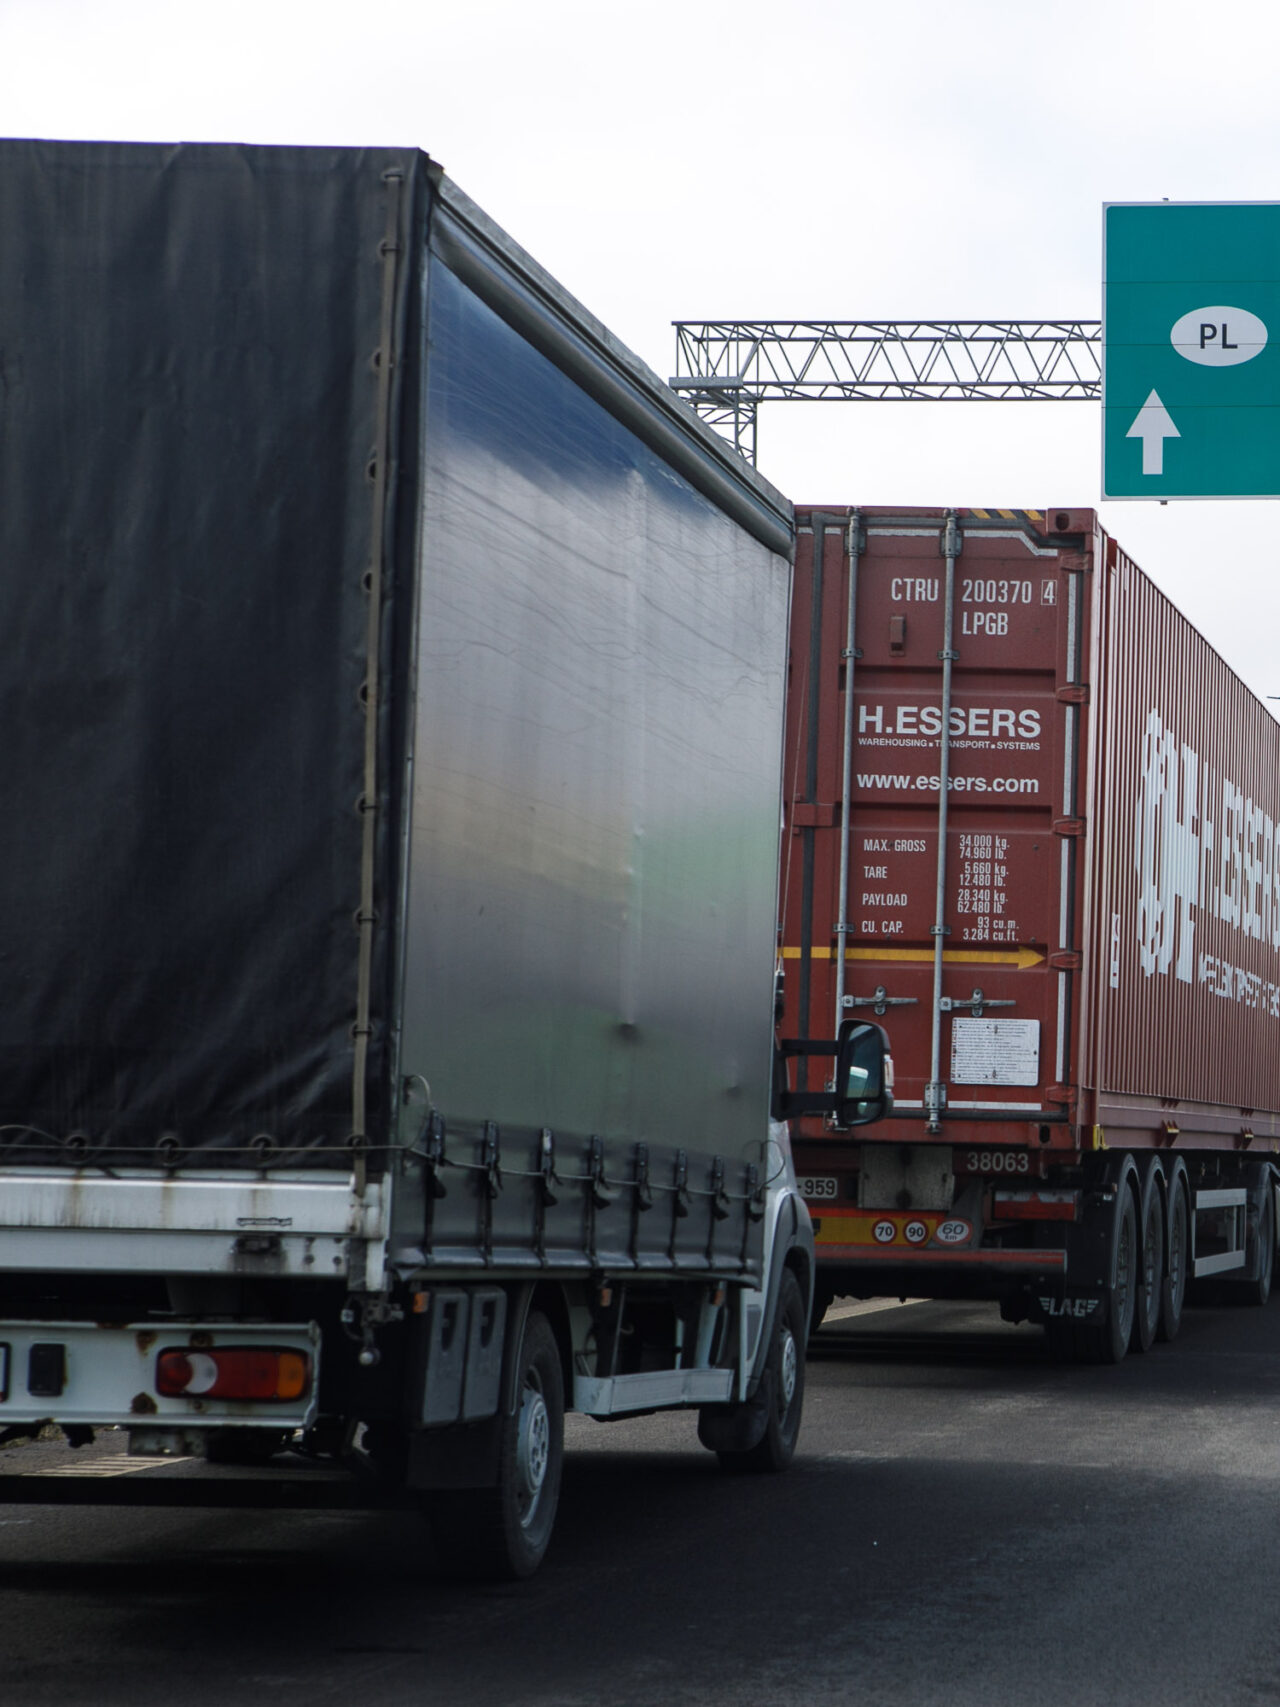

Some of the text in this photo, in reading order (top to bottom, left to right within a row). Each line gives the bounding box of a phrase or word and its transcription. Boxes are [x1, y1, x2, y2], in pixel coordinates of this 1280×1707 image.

[1199, 323, 1238, 350] PL
[891, 578, 1055, 604] CTRU 200370 4
[962, 612, 1009, 635] LPGB
[859, 705, 1041, 738] H.ESSERS
[858, 738, 1041, 750] WAREHOUSING TANSPORT SYSTEMS
[863, 839, 926, 852] MAX. GROSS
[959, 834, 992, 847] 34.000
[959, 847, 991, 859] 74.960
[863, 866, 888, 879] TARE
[964, 861, 991, 874] 5.660
[959, 874, 991, 886] 12.480
[862, 893, 908, 906] PAYLOAD
[958, 888, 990, 901] 28.340
[957, 900, 990, 913] 62.480
[861, 920, 904, 934] CU. CAP.
[977, 916, 990, 929] 93
[963, 928, 990, 940] 3.284
[967, 1152, 1029, 1172] 38063
[877, 1226, 893, 1237] 70
[908, 1227, 924, 1238] 90
[942, 1223, 965, 1235] 60
